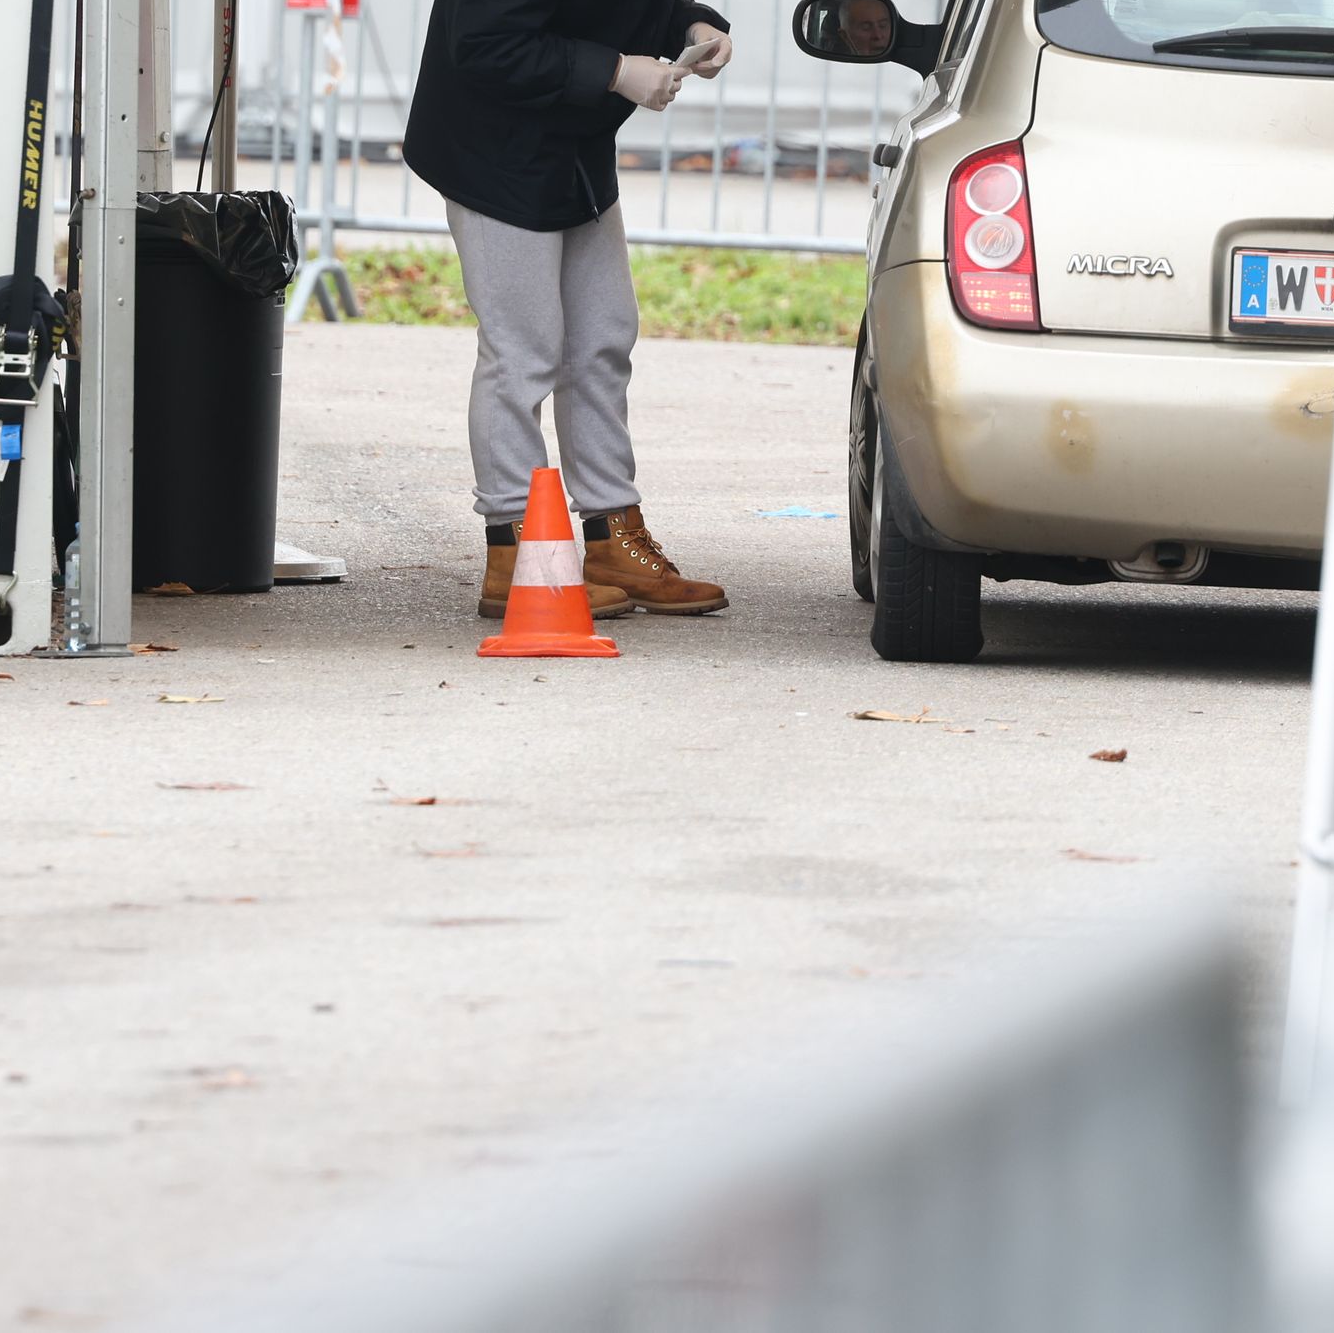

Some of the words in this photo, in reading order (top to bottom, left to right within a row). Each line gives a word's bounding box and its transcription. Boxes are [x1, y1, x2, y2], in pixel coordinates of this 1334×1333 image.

[223, 7, 232, 88] SAAS
[1067, 254, 1175, 278] MICRA
[1247, 294, 1260, 308] A
